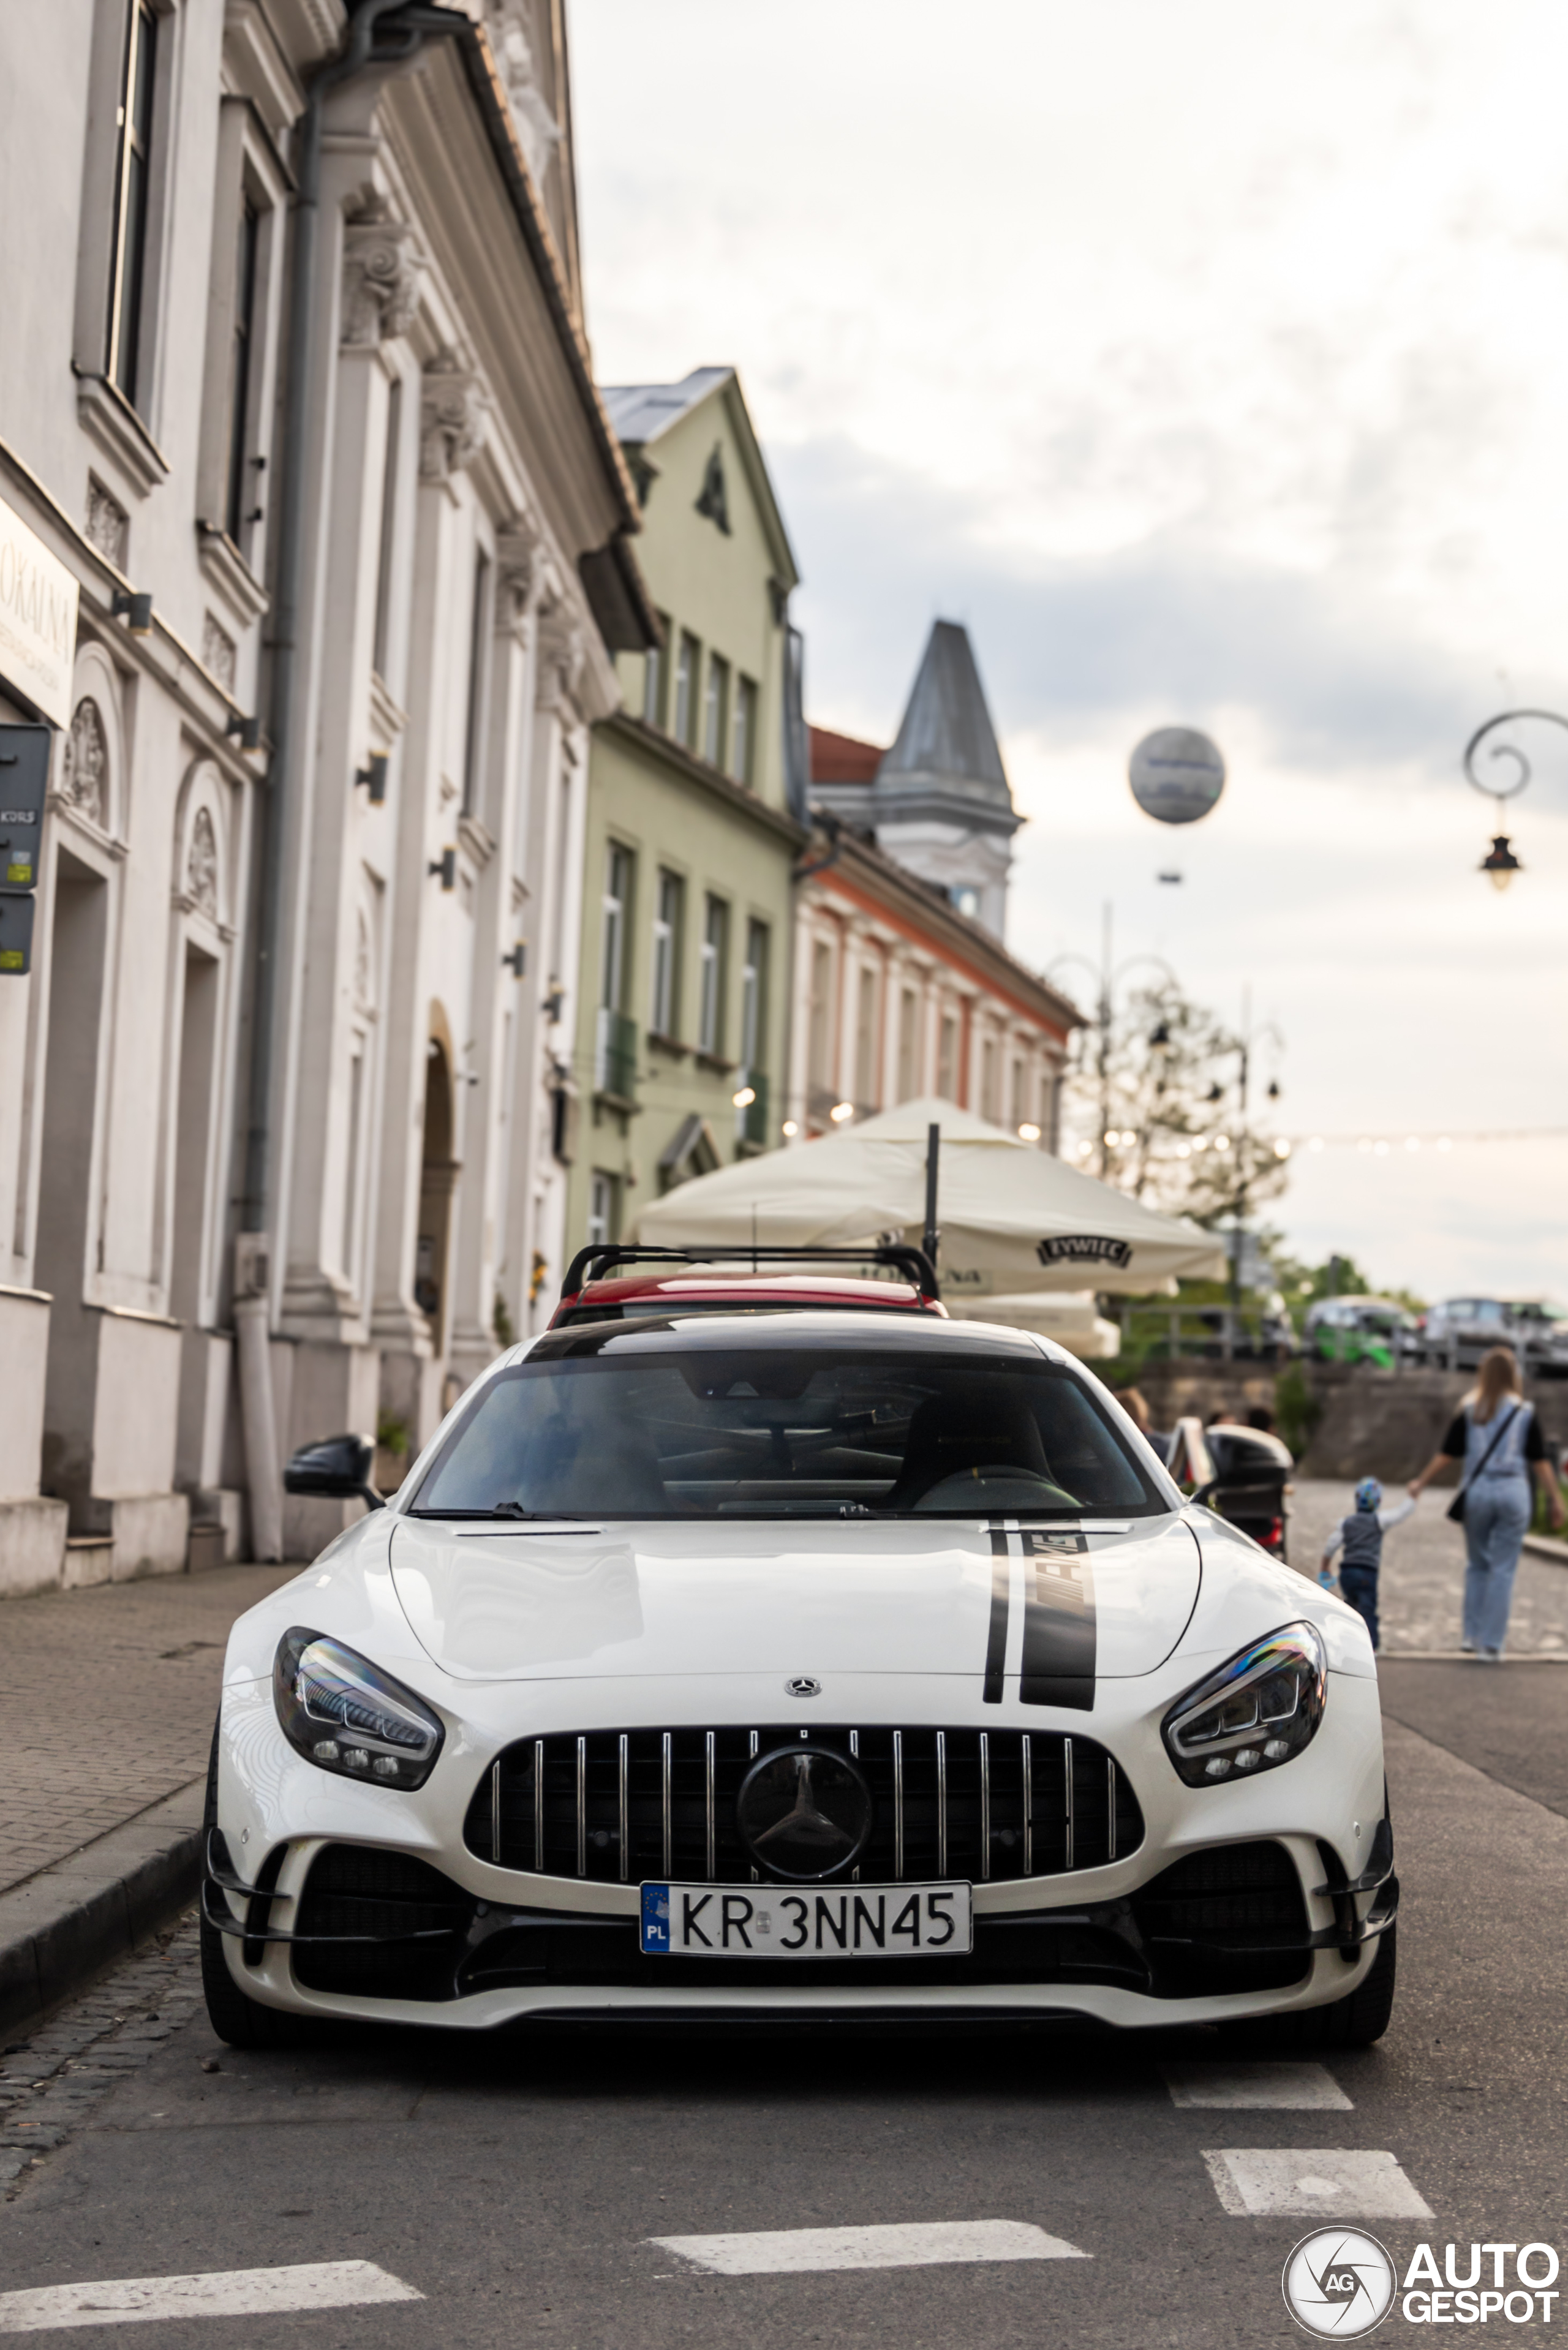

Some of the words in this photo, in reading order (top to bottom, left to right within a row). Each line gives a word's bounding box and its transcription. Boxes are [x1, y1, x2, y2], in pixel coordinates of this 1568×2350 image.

[647, 1925, 666, 1940] PL
[683, 1893, 753, 1948] KR
[779, 1892, 955, 1949] 3NN45
